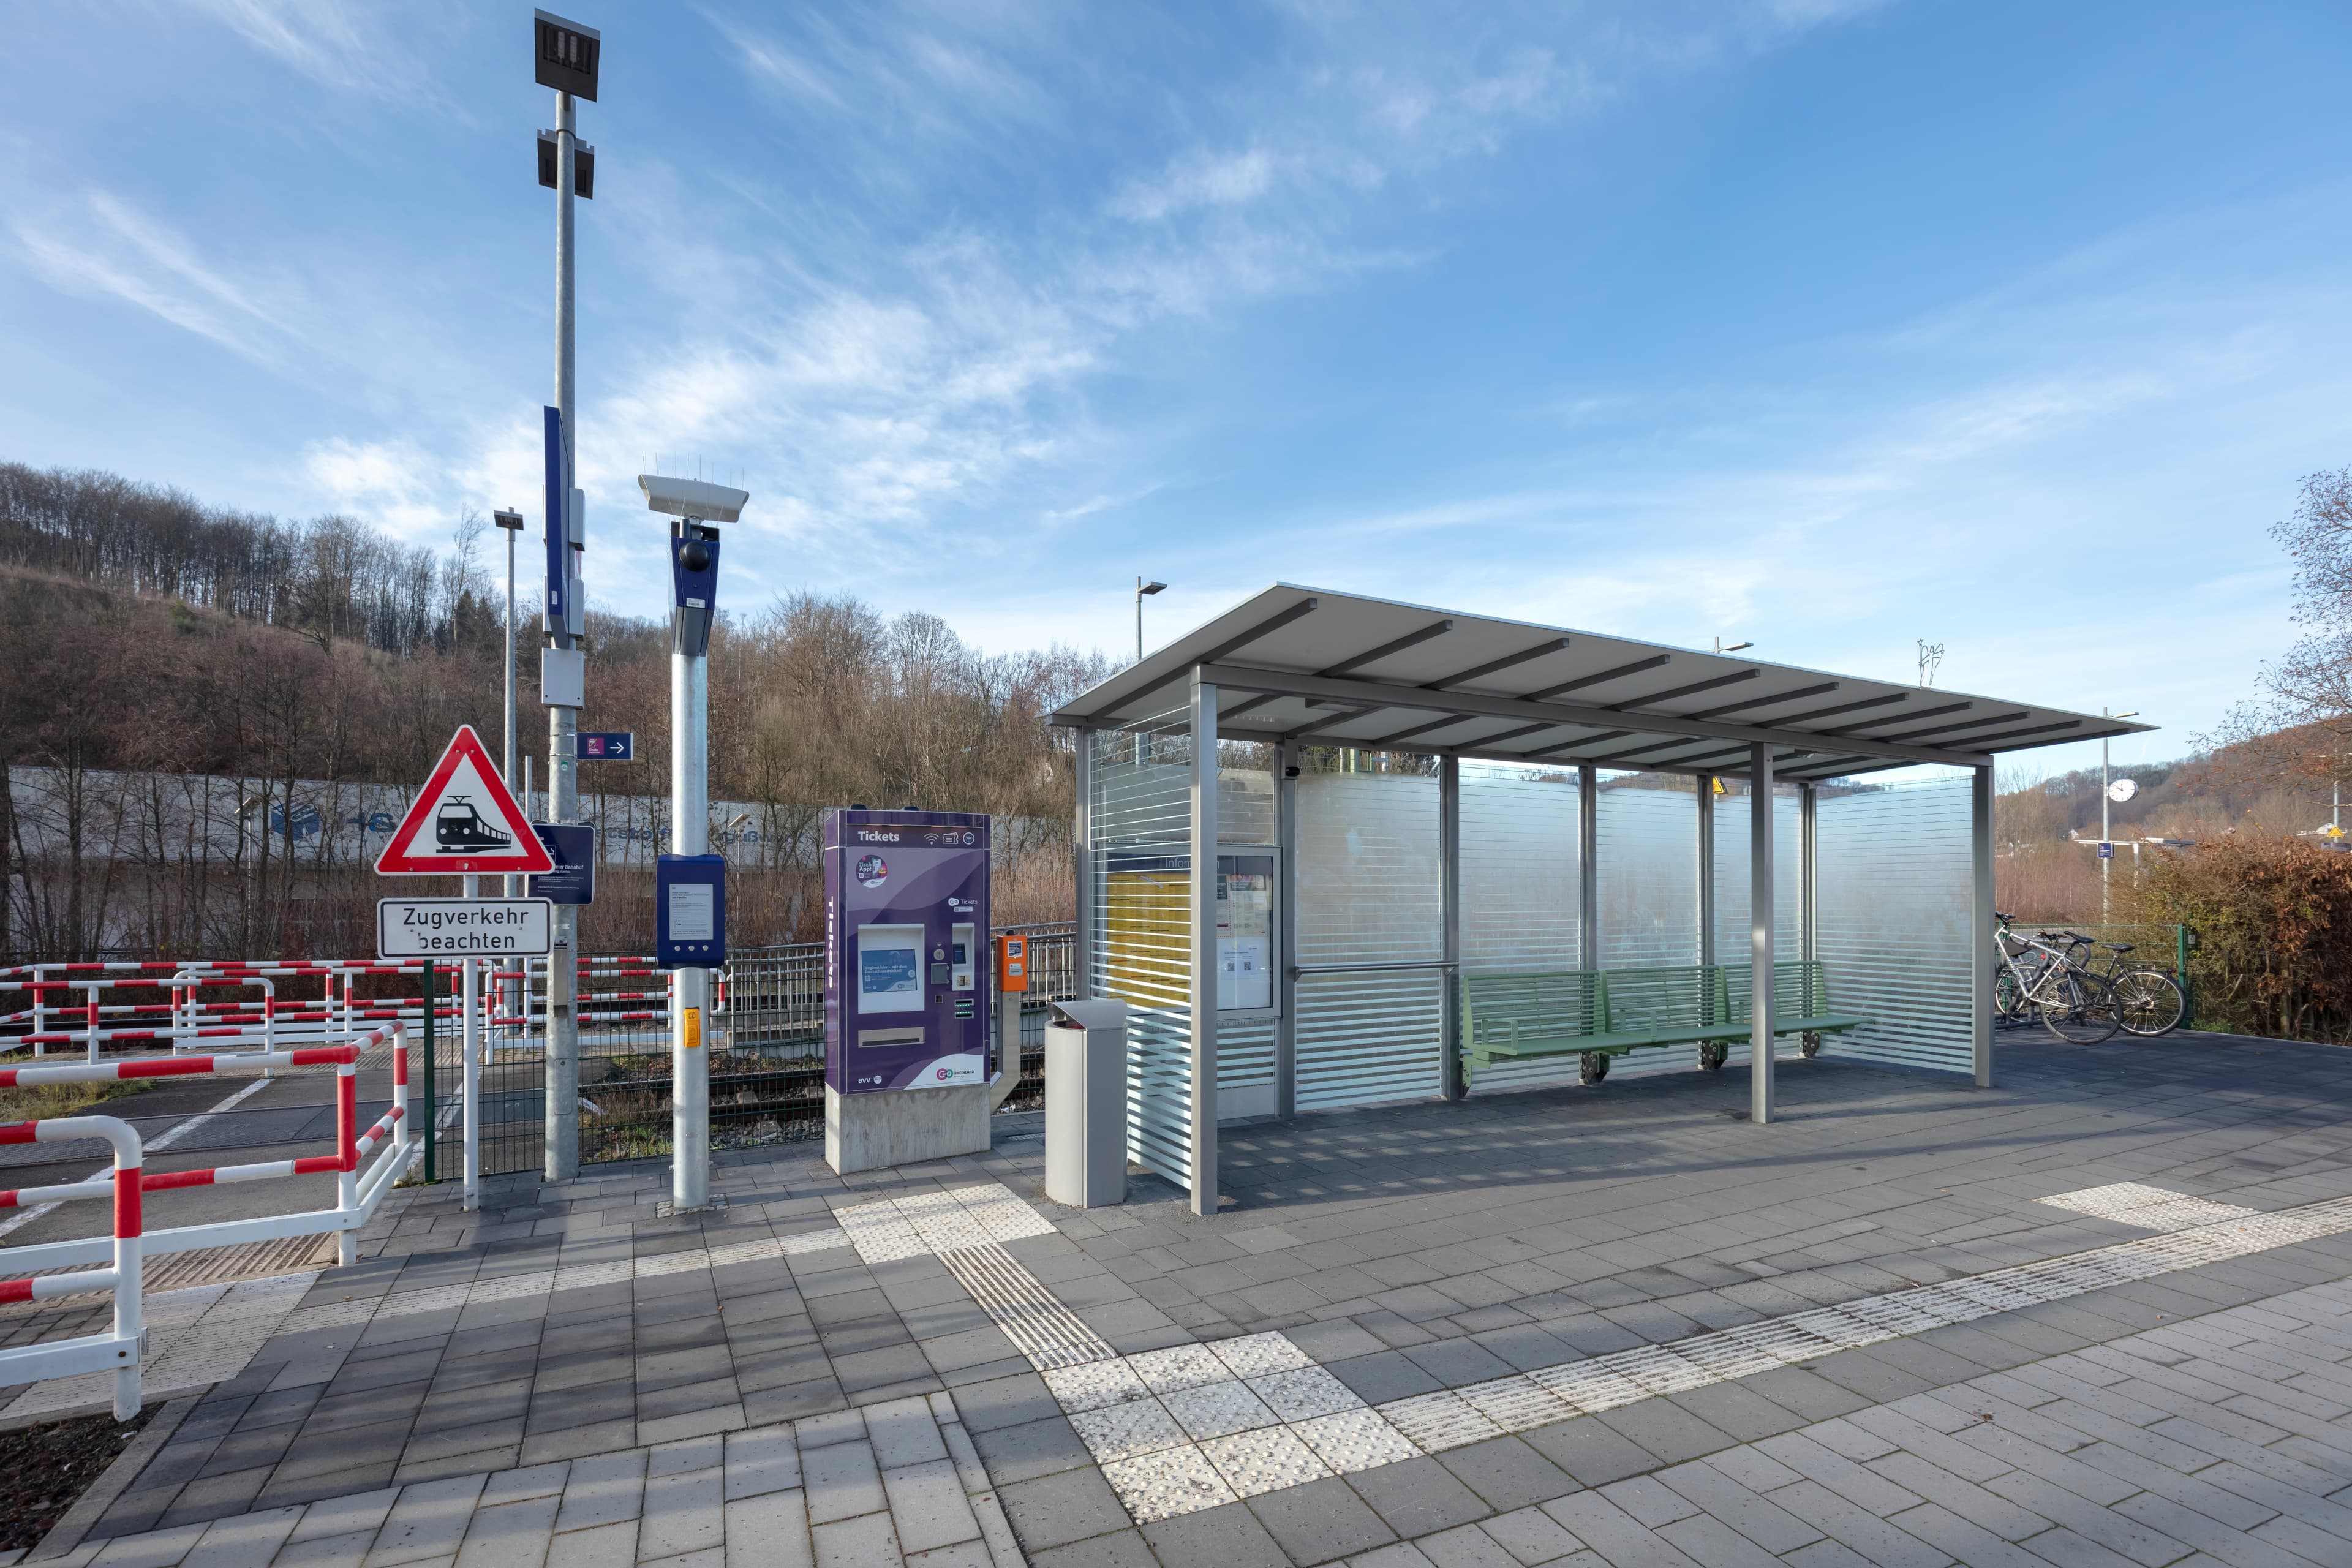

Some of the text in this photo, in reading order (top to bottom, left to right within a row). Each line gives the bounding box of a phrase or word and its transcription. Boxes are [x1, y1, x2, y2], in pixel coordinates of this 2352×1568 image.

[858, 831, 900, 842] Tickets
[403, 907, 529, 929] Zugverkehr
[418, 932, 515, 949] beachten
